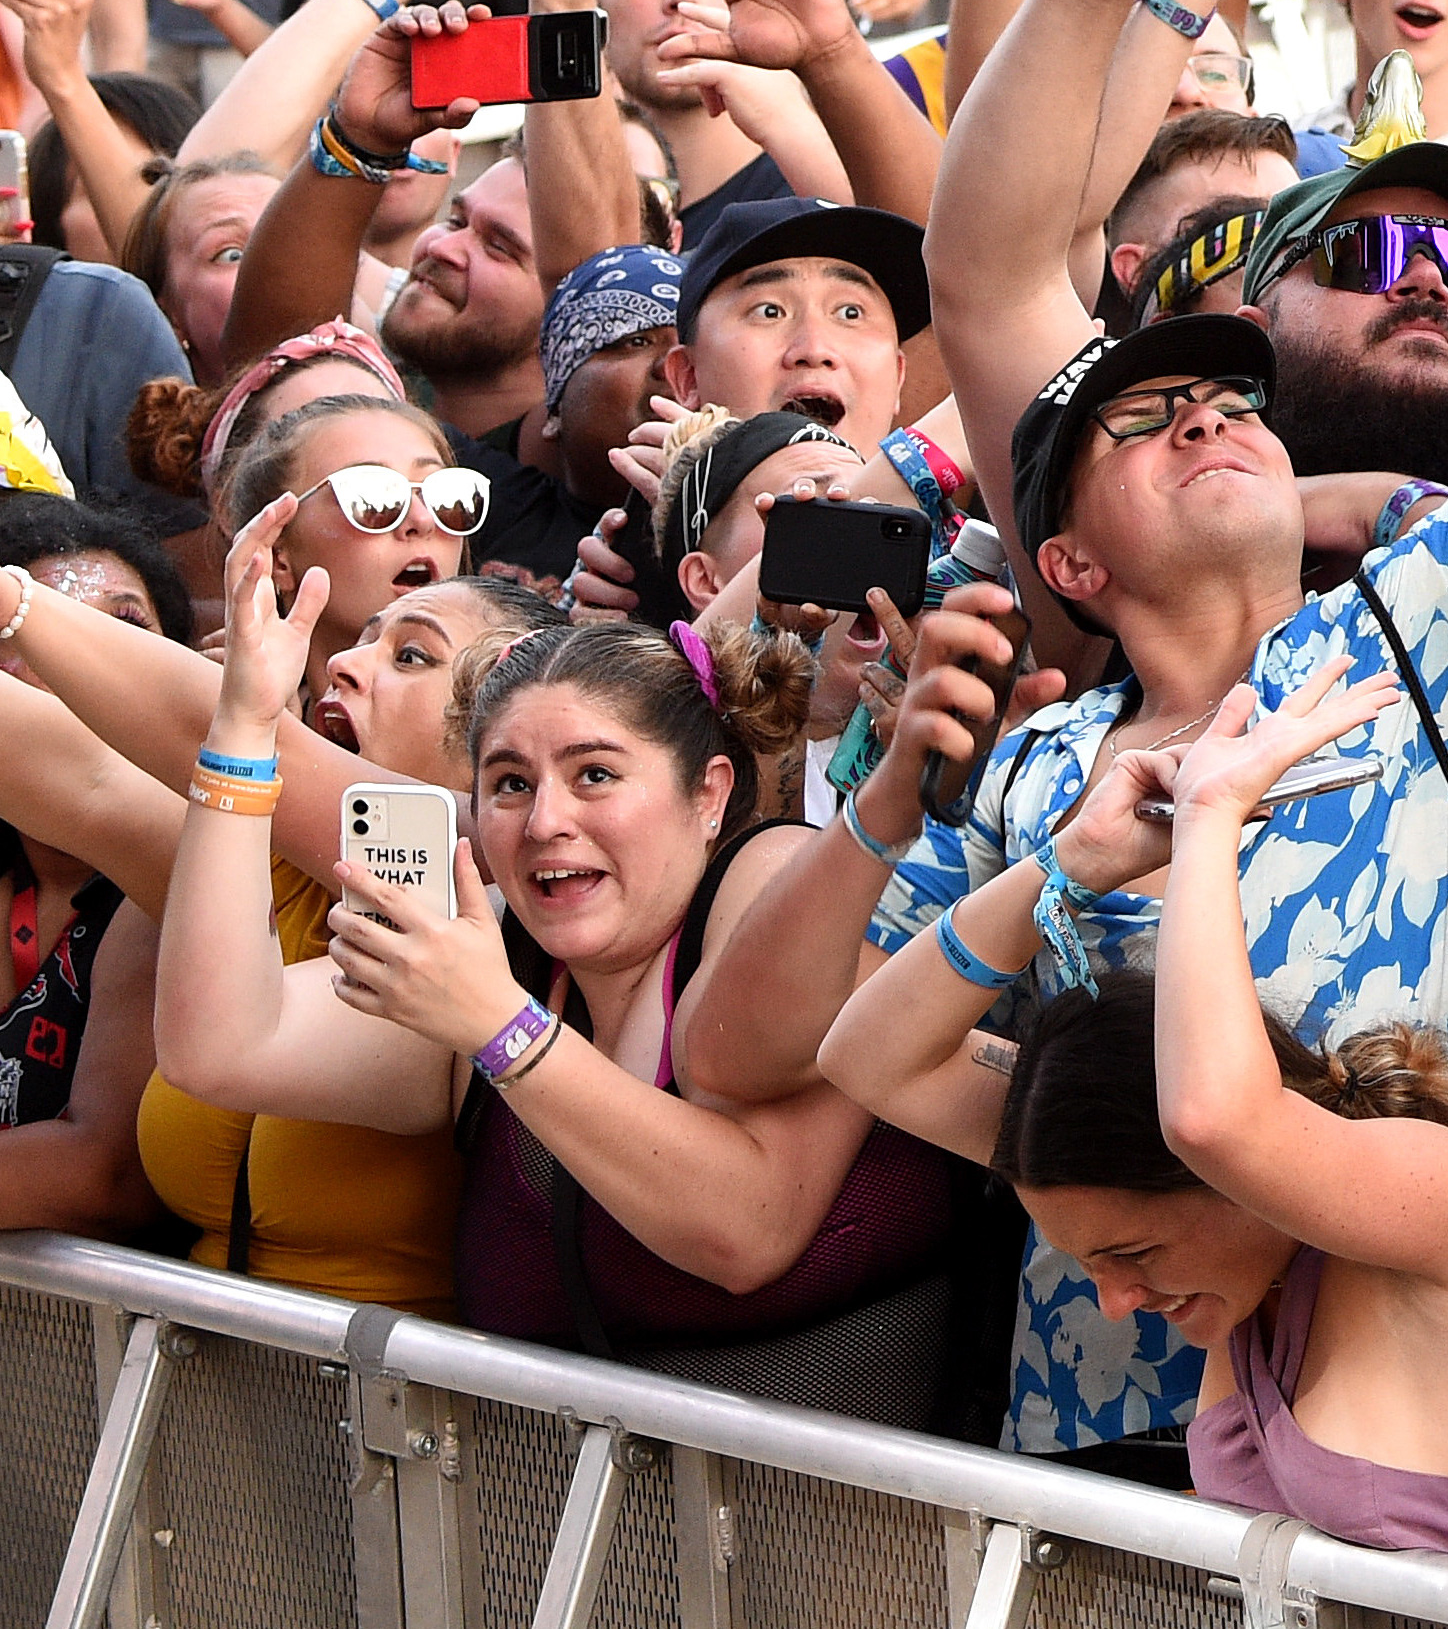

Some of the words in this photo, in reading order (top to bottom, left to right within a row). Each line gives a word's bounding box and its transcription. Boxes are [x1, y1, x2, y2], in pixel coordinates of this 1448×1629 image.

[364, 847, 407, 864] THIS
[412, 849, 428, 864] IS
[505, 1027, 533, 1060] GA
